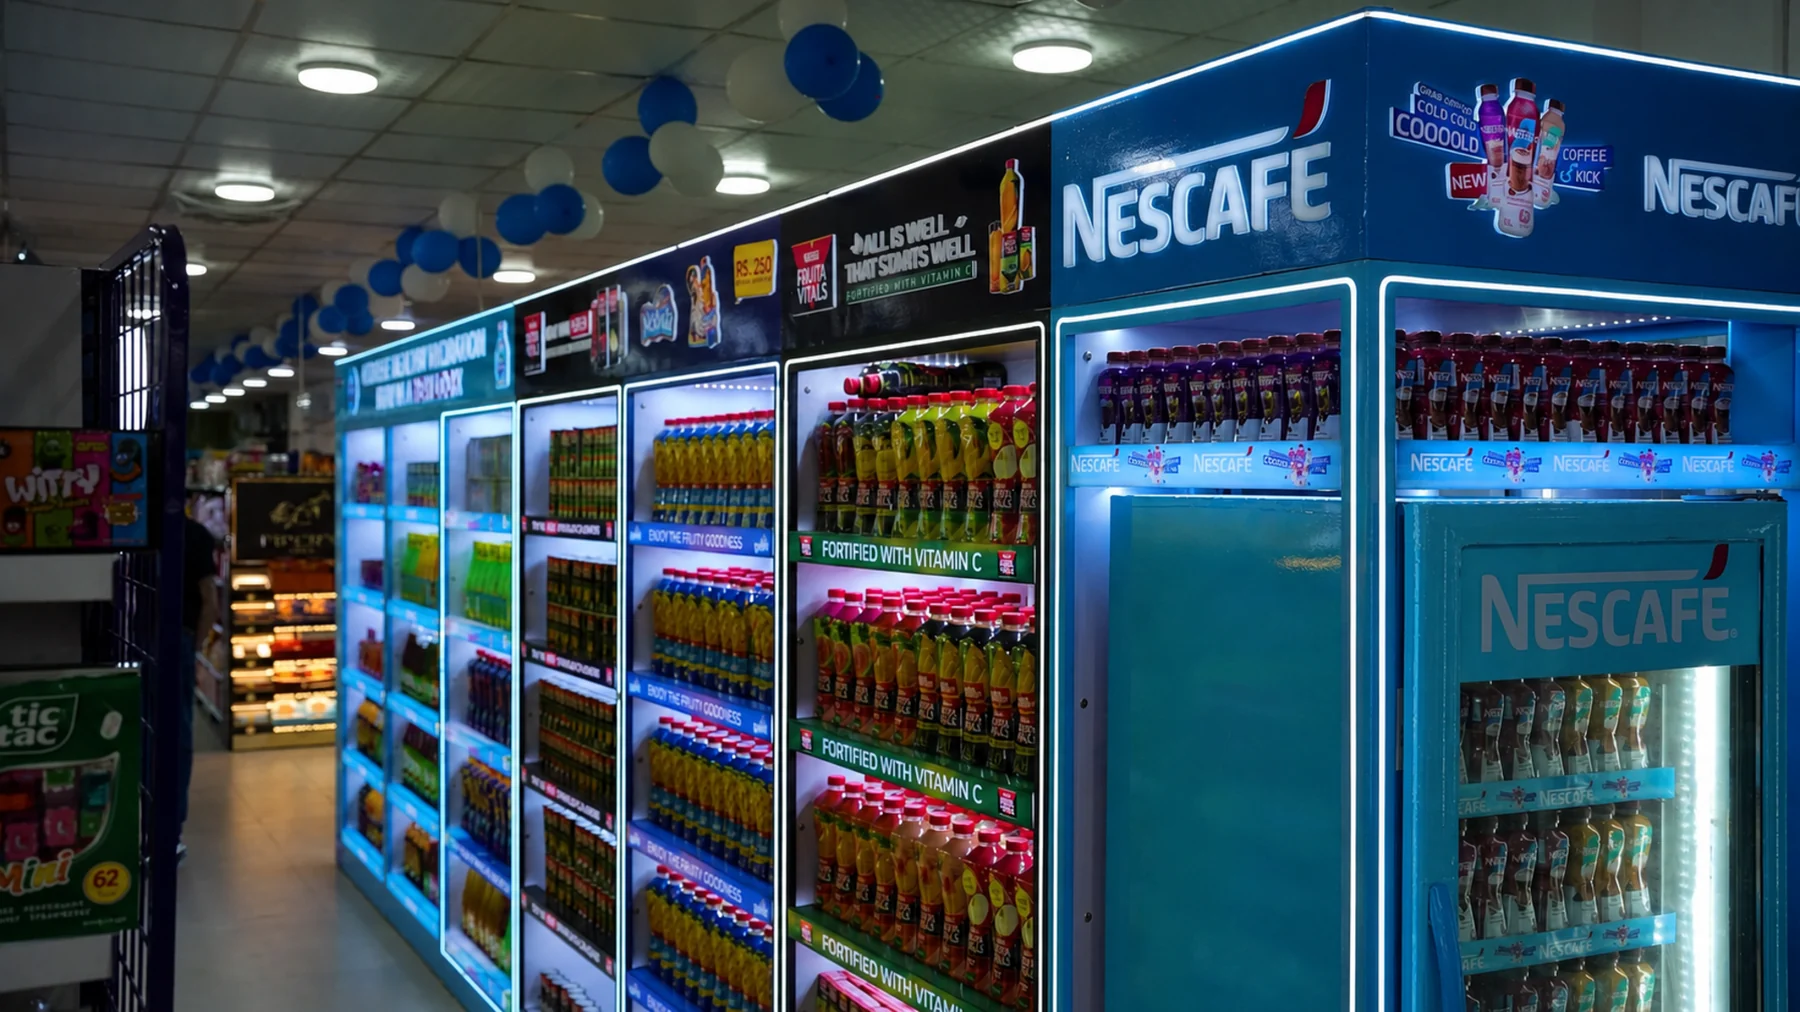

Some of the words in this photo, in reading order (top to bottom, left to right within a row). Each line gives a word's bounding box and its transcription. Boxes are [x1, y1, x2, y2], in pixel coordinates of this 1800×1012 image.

[1417, 99, 1448, 121] COLD
[1450, 112, 1476, 131] COLD
[1395, 113, 1479, 154] COOOOLD
[1562, 148, 1608, 163] COFFEE
[1451, 171, 1489, 191] NEW
[1575, 170, 1601, 185] KICK
[1644, 154, 1800, 227] NESCAF
[890, 225, 905, 249] IS
[905, 213, 950, 244] WELL
[753, 255, 771, 276] 250
[797, 263, 827, 286] FRUITA
[844, 257, 878, 284] THAT
[930, 234, 977, 264] WELL
[797, 282, 828, 304] VITALS
[846, 283, 890, 301] FORTIFIED
[894, 277, 917, 292] WITH
[920, 268, 960, 285] VITAMIN
[822, 540, 878, 563] FORTIFIED
[880, 545, 912, 566] WITH
[914, 548, 968, 571] VITAMIN
[972, 552, 982, 573] C
[10, 703, 61, 728] tic
[822, 737, 878, 771] FORTIFIED
[880, 755, 912, 783] WITH
[914, 766, 968, 800] VITAMIN
[972, 784, 982, 804] C
[93, 868, 119, 889] 62
[822, 934, 878, 979] FORTIFIED
[880, 964, 912, 999] WITH
